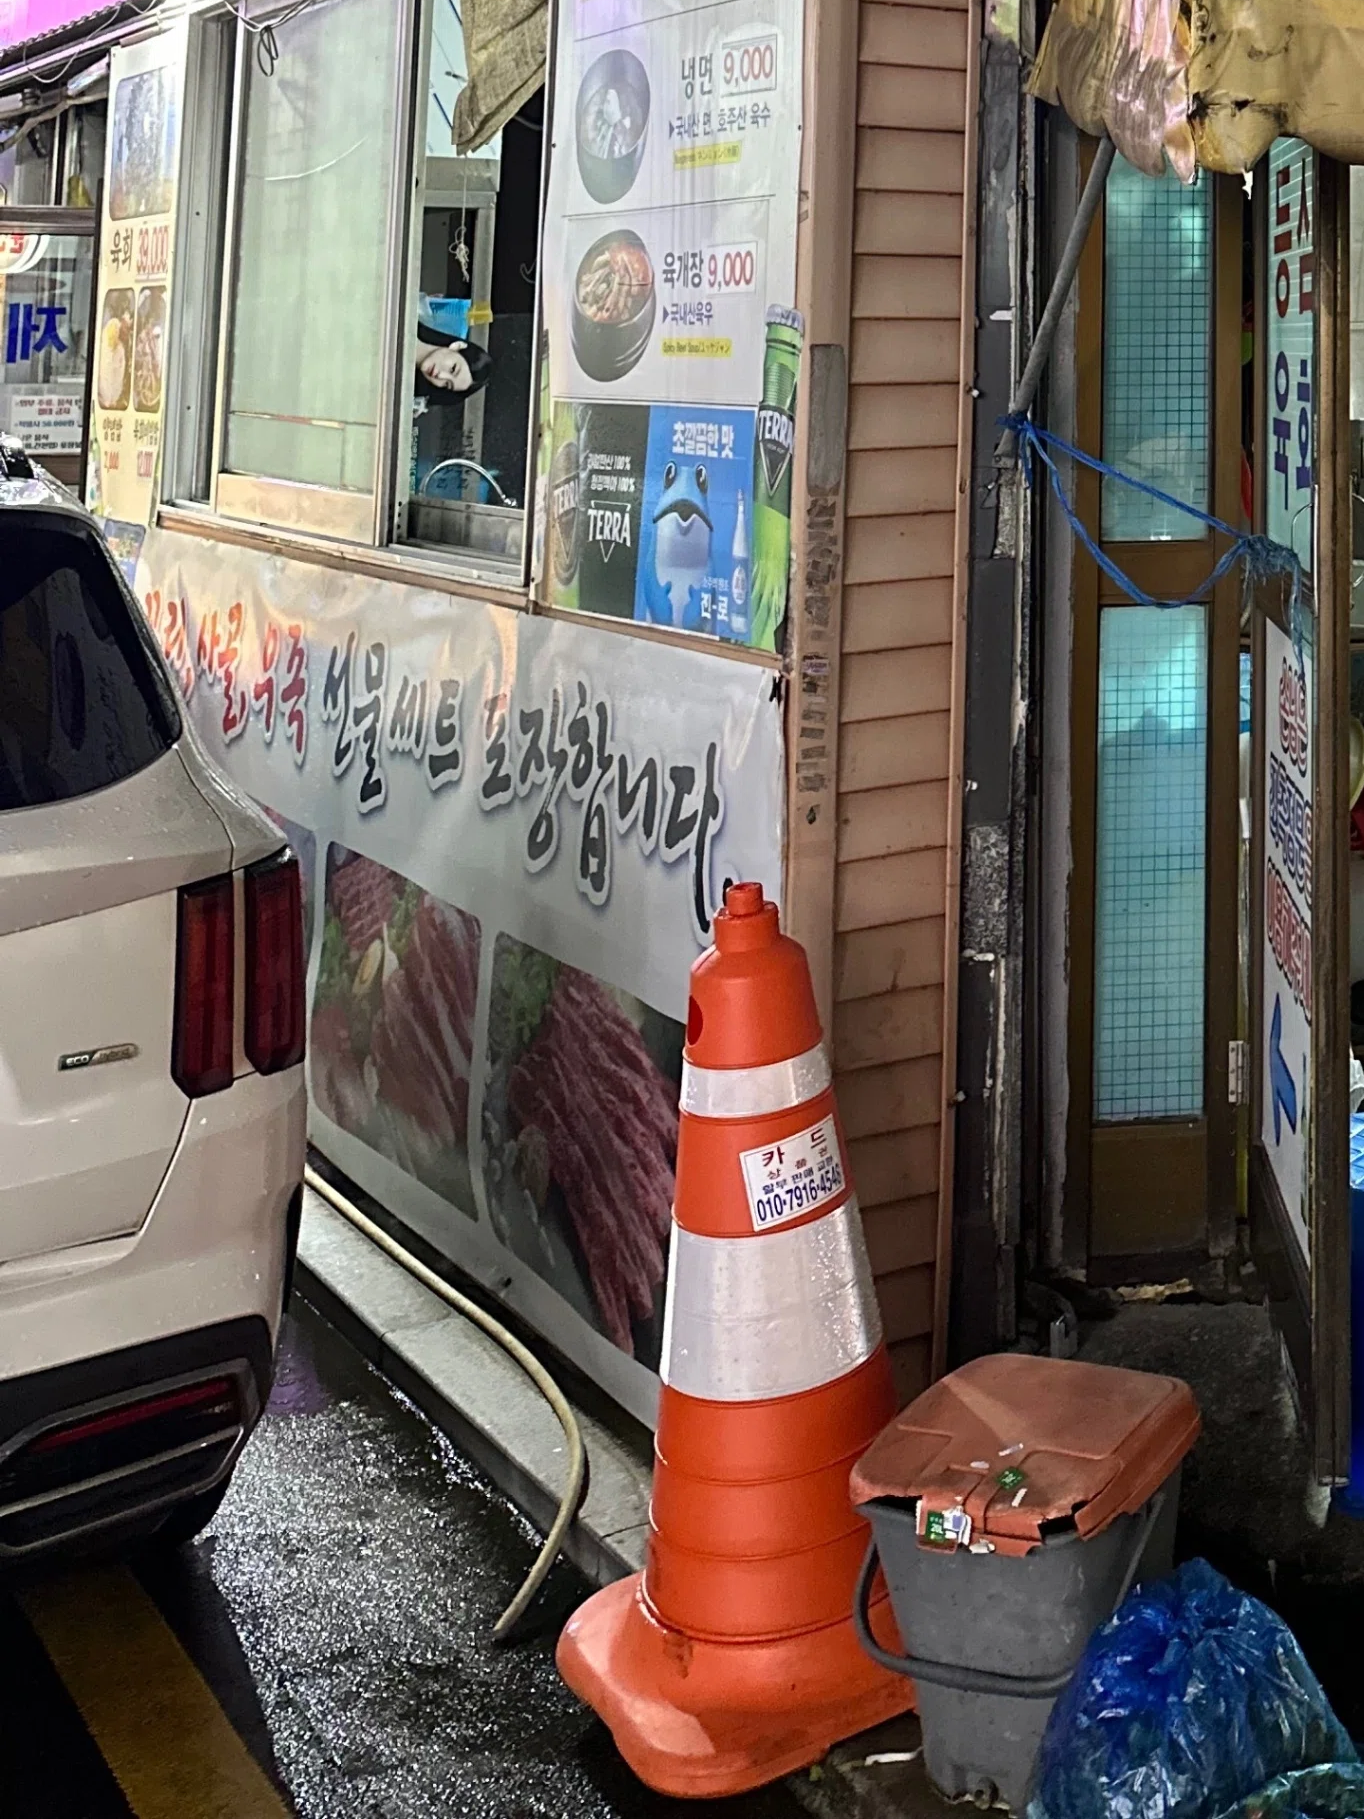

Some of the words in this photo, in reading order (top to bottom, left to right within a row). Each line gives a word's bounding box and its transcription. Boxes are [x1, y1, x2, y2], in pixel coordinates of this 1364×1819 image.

[681, 53, 713, 100] 냉면
[723, 44, 773, 87] 9,000
[110, 228, 134, 273] 육회
[662, 250, 704, 289] 육개장
[708, 250, 754, 291] 9,000
[721, 424, 734, 459] 맛
[588, 508, 631, 547] TERRA
[254, 621, 306, 755] 우족
